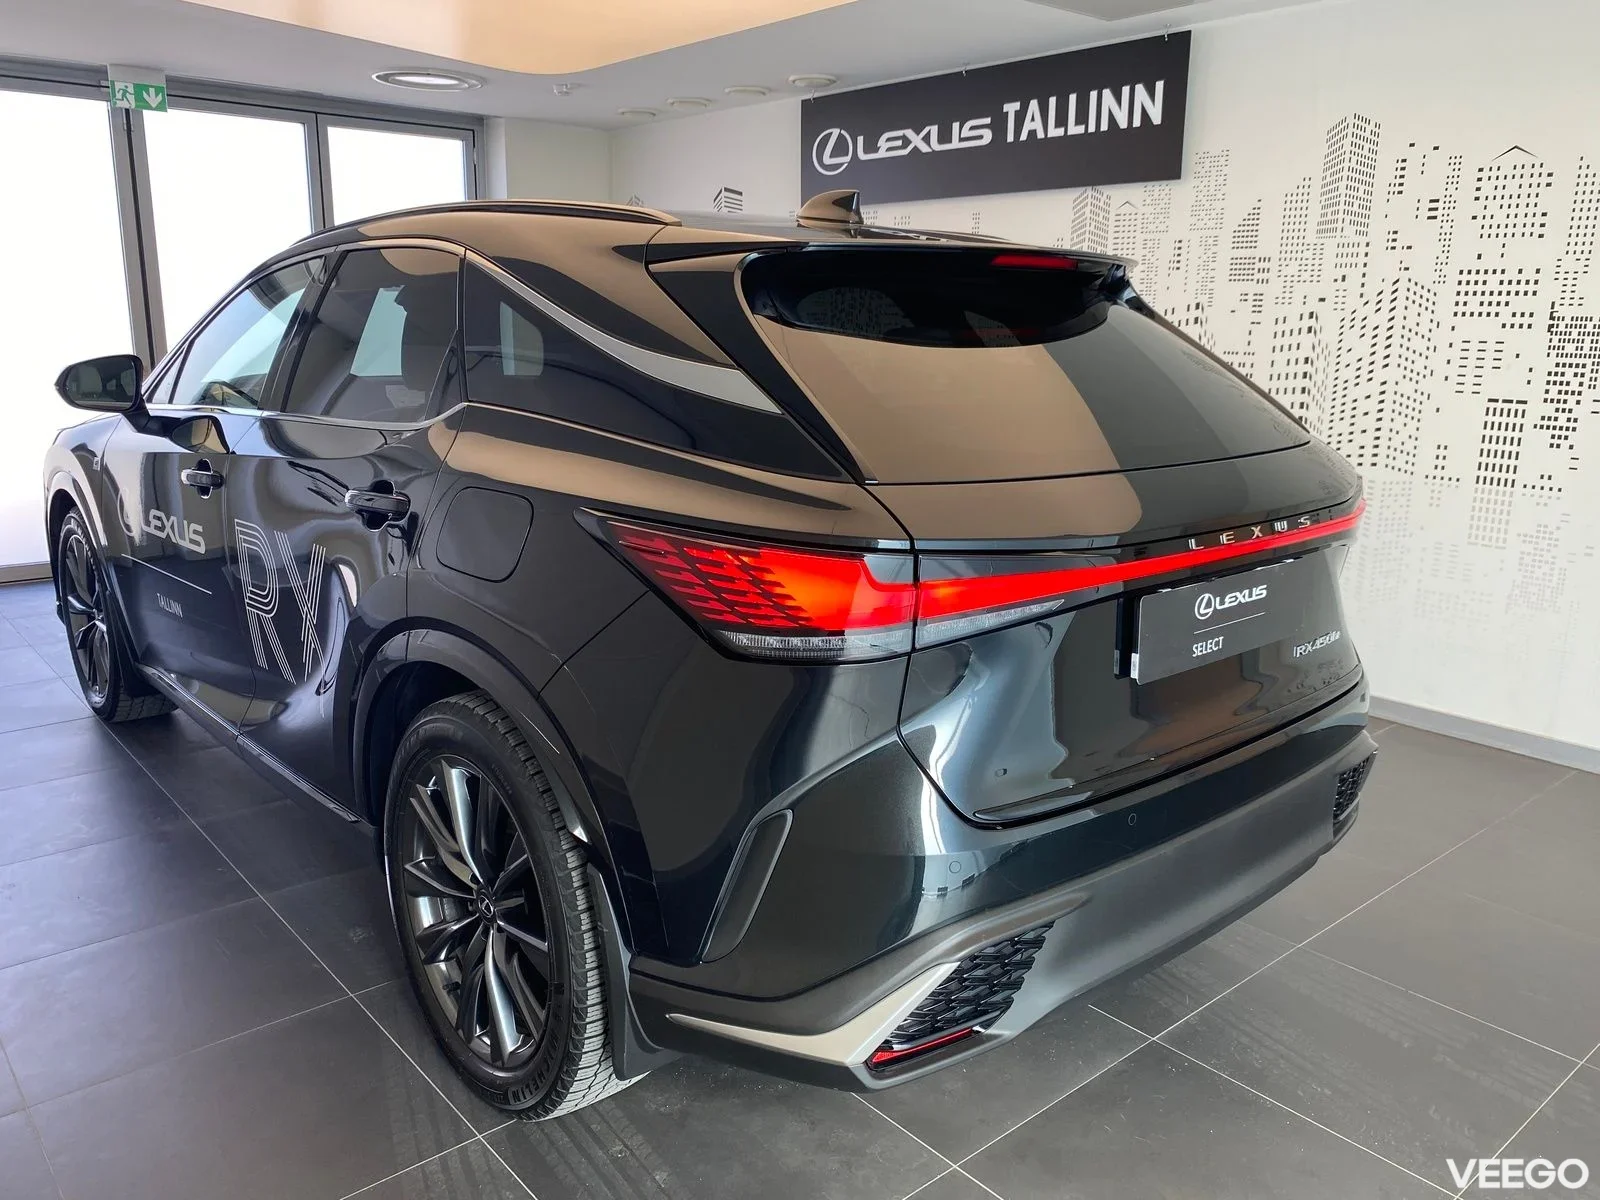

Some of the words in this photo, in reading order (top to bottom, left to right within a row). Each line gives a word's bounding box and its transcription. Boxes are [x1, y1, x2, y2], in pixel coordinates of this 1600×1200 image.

[857, 116, 993, 160] LEXUS
[1003, 80, 1165, 143] TALLINN
[140, 508, 206, 554] LEXUS
[1188, 515, 1311, 550] LEXUS
[157, 593, 183, 618] TALLINN
[234, 518, 327, 686] RX
[1215, 584, 1268, 610] LEXUS
[1192, 636, 1225, 658] SELECT
